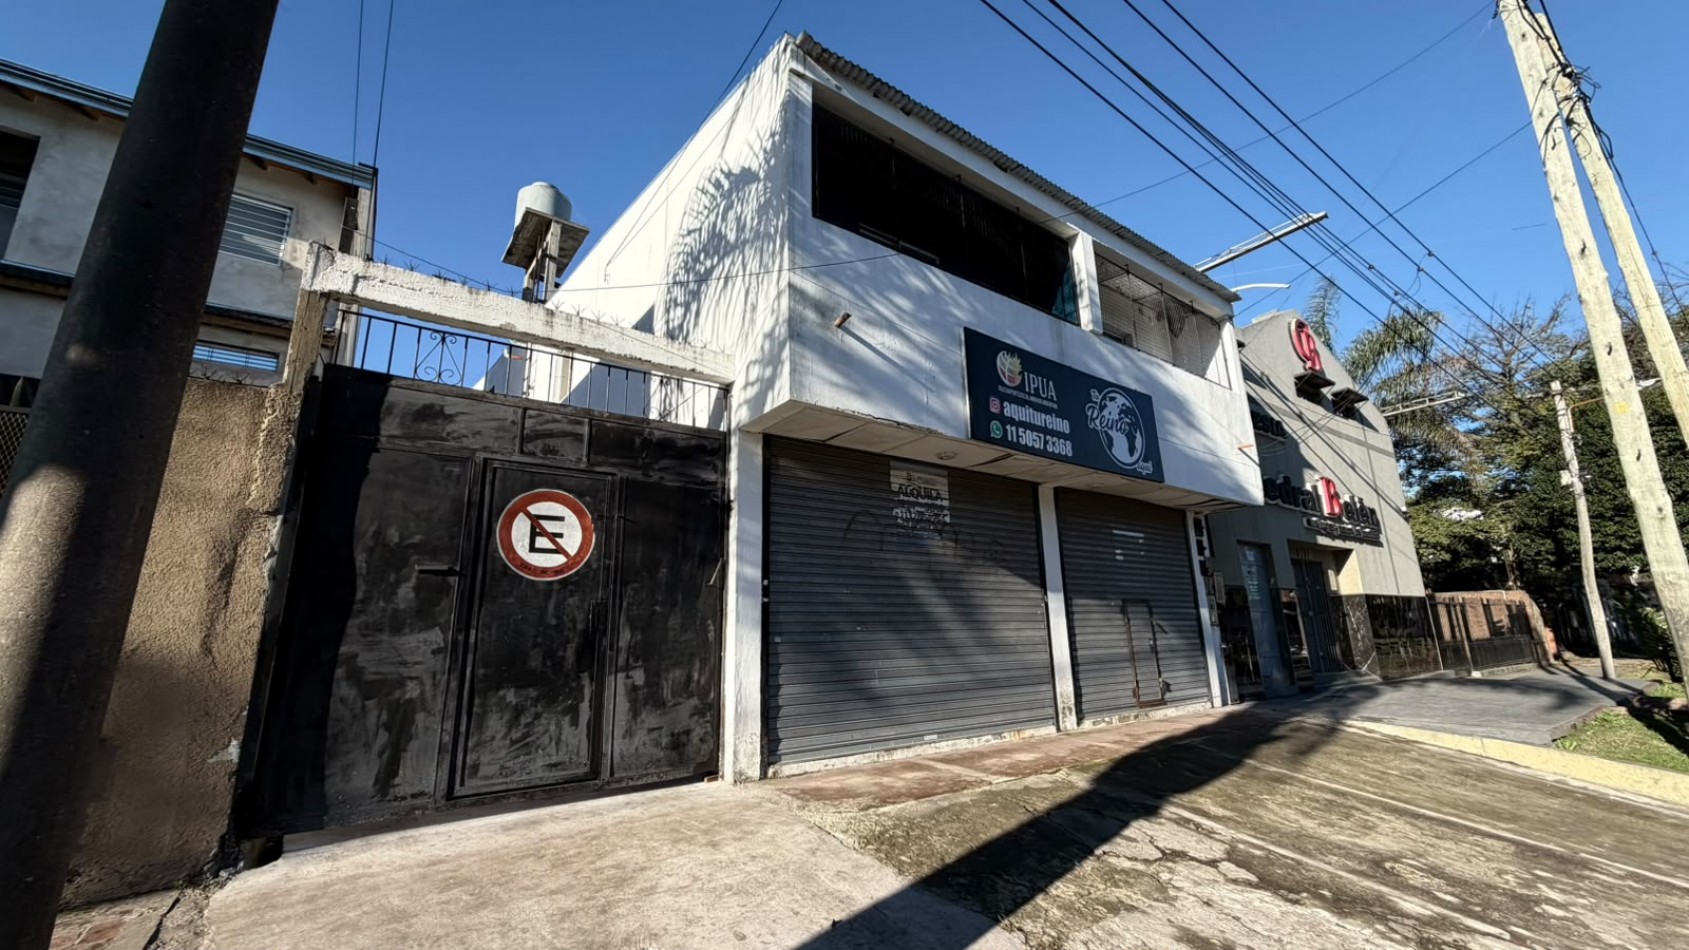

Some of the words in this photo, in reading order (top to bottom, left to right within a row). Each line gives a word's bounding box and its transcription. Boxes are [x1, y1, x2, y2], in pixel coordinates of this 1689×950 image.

[1023, 371, 1058, 401] IPUA
[1003, 401, 1070, 434] aquitureino
[1085, 403, 1129, 435] Reino
[1005, 424, 1017, 442] 11
[1019, 428, 1045, 449] 5057
[1046, 434, 1073, 457] 3368
